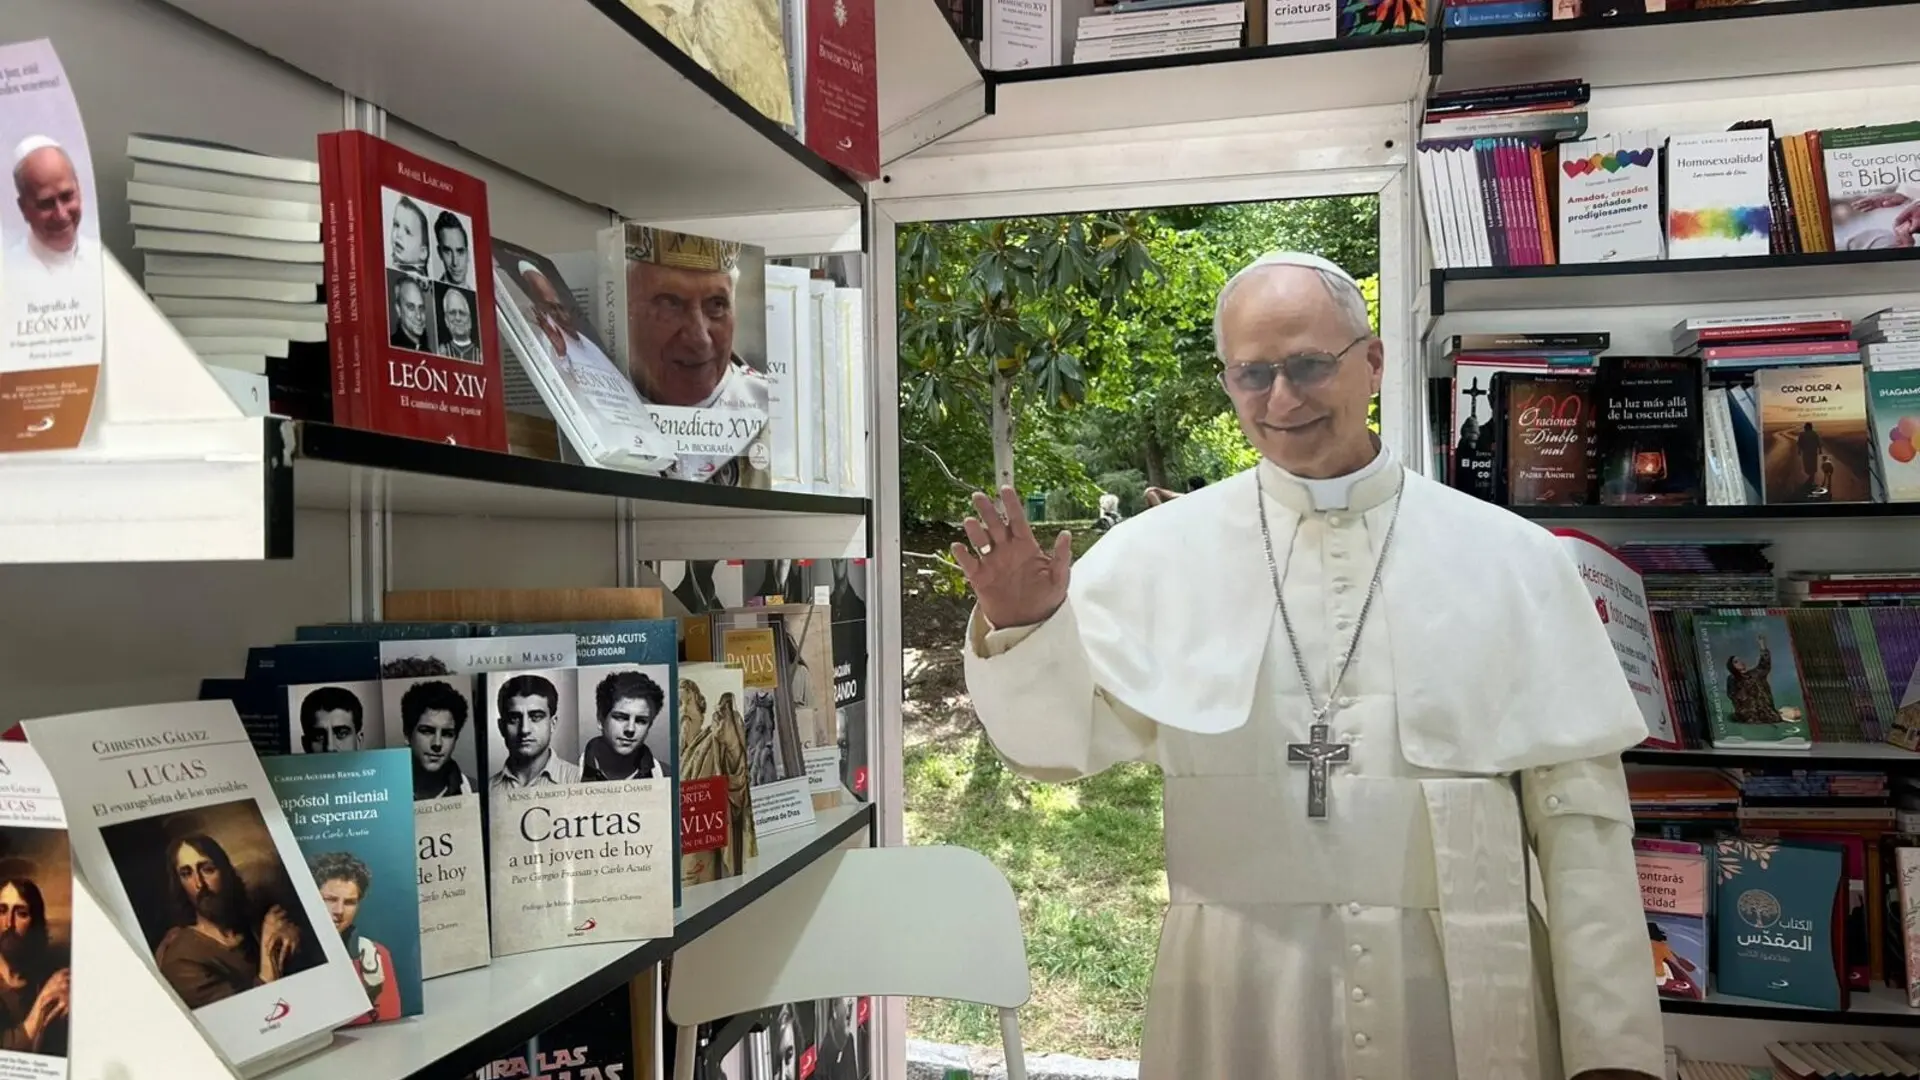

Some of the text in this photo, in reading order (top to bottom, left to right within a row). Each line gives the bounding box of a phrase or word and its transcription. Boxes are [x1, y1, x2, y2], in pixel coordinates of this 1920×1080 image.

[1274, 1, 1331, 16] criaturas
[1677, 153, 1763, 169] Homosexualidad
[1611, 185, 1649, 198] creados
[1592, 197, 1632, 210] soñados
[1567, 203, 1649, 223] prodigiosamente
[17, 315, 91, 337] LEÓN XIV
[388, 359, 487, 400] LEÓN XIV
[1781, 385, 1802, 394] CON
[1804, 384, 1832, 393] OLOR
[439, 400, 448, 413] de
[1609, 396, 1687, 408] La luz más allá
[1796, 395, 1828, 405] OVEJA
[1518, 406, 1578, 428] Oraciones
[1607, 407, 1688, 420] de la oscuridad
[650, 409, 723, 437] Benedicto
[677, 440, 689, 452] LA
[1461, 459, 1470, 468] El
[576, 632, 647, 645] SALZANO ACUTIS
[467, 652, 564, 667] JAVIER MANSO
[598, 647, 626, 656] RODARI
[92, 728, 210, 756] CHRISTIAN GÁLVEZ
[126, 758, 208, 790] LUCAS
[93, 801, 110, 818] El
[111, 793, 172, 815] evangelista
[174, 787, 188, 802] de
[205, 780, 249, 797] invisibles
[280, 791, 329, 810] apóstol
[294, 809, 378, 826] la esperanza
[520, 806, 641, 842] Cartas
[418, 832, 454, 860] as
[509, 840, 654, 867] a un joven de hoy
[438, 864, 467, 882] hoy
[1638, 872, 1684, 883] ontrarás
[1640, 885, 1677, 896] serena
[535, 1045, 588, 1072] LAS
